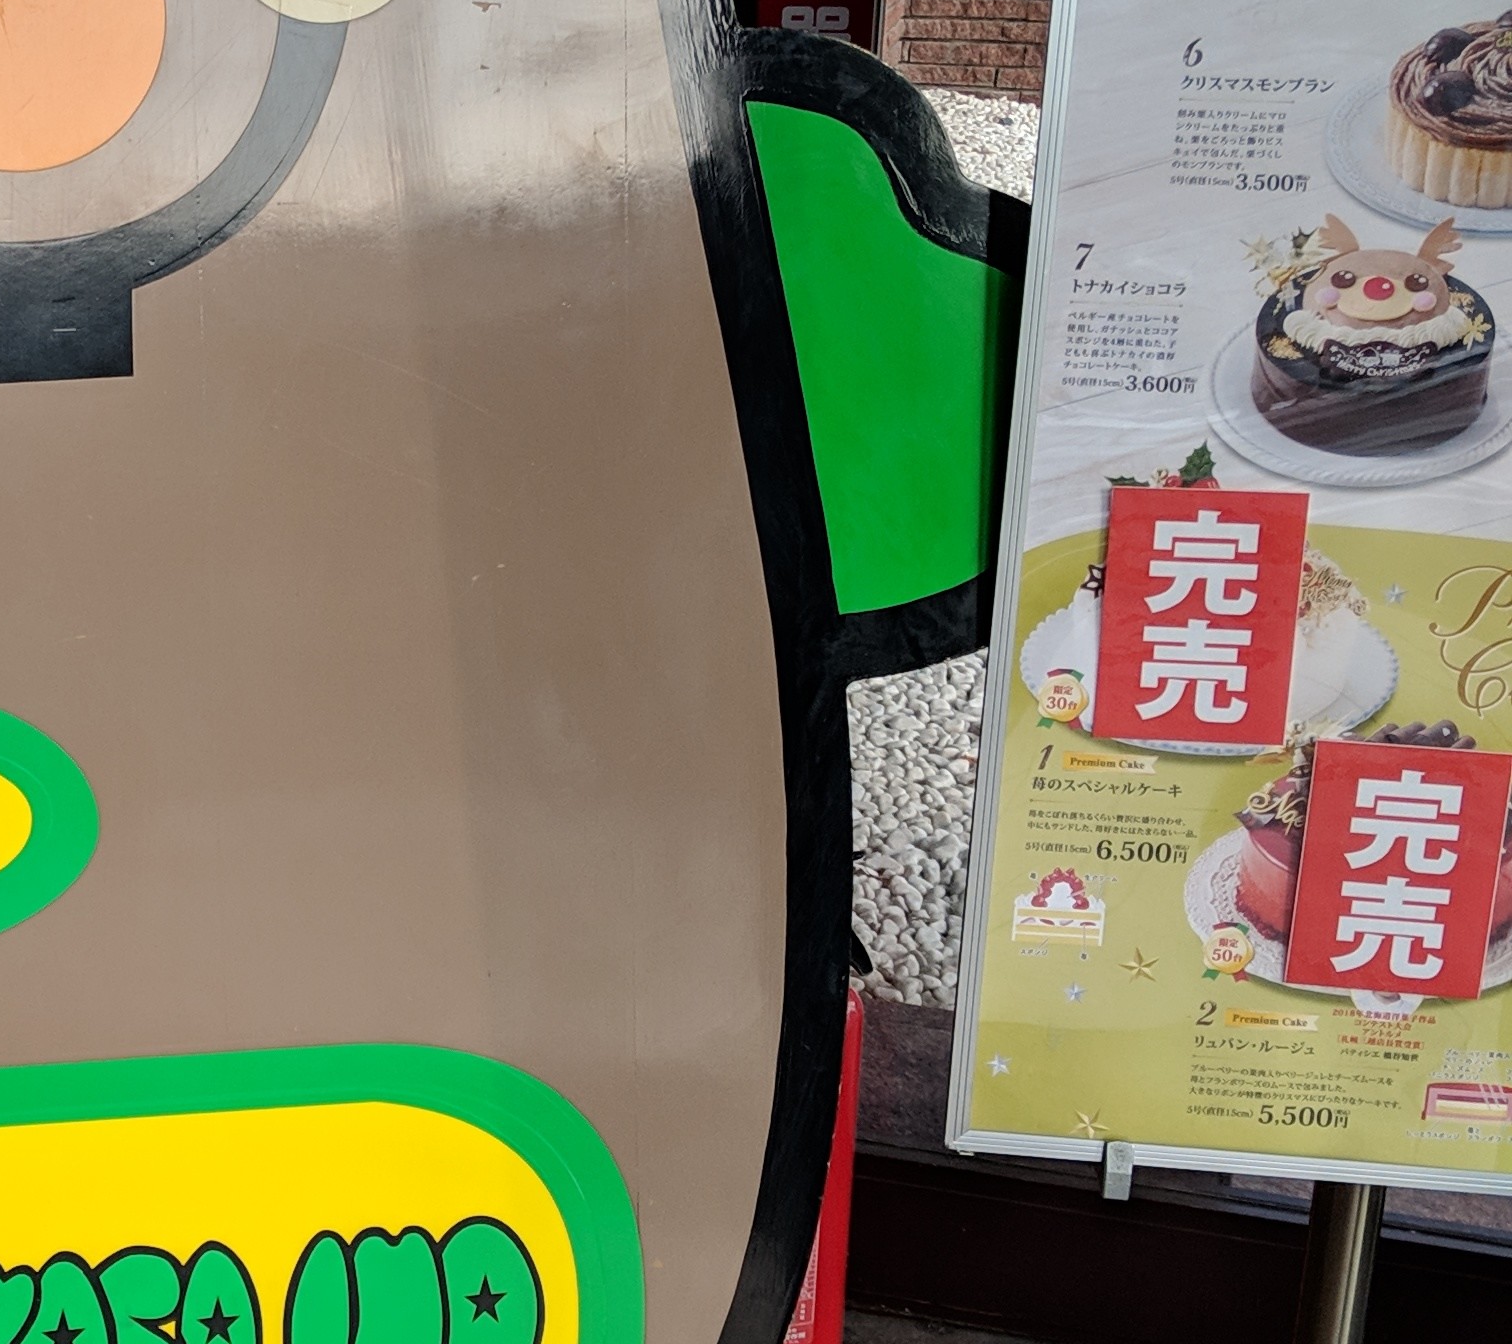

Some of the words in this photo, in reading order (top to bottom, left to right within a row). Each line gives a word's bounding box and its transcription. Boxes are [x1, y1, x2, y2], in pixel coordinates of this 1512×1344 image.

[1182, 37, 1204, 68] 6
[1180, 75, 1336, 94] クリスマスモンブラン
[1074, 243, 1095, 271] 7
[1072, 278, 1187, 297] トナカイショコラ
[1134, 509, 1261, 725] 完売
[1052, 684, 1074, 696] 限定
[1046, 696, 1079, 712] 30台
[1038, 744, 1054, 770] 1
[1069, 756, 1117, 769] Premium
[1118, 760, 1146, 771] Cake
[1032, 776, 1183, 799] 苺のスペシャルケーキ
[1329, 769, 1464, 981] 完売
[1218, 937, 1239, 948] 限定
[1211, 949, 1243, 963] 50台
[1195, 1000, 1218, 1027] 2
[1232, 1013, 1279, 1025] Premium
[1281, 1016, 1309, 1028] Cake
